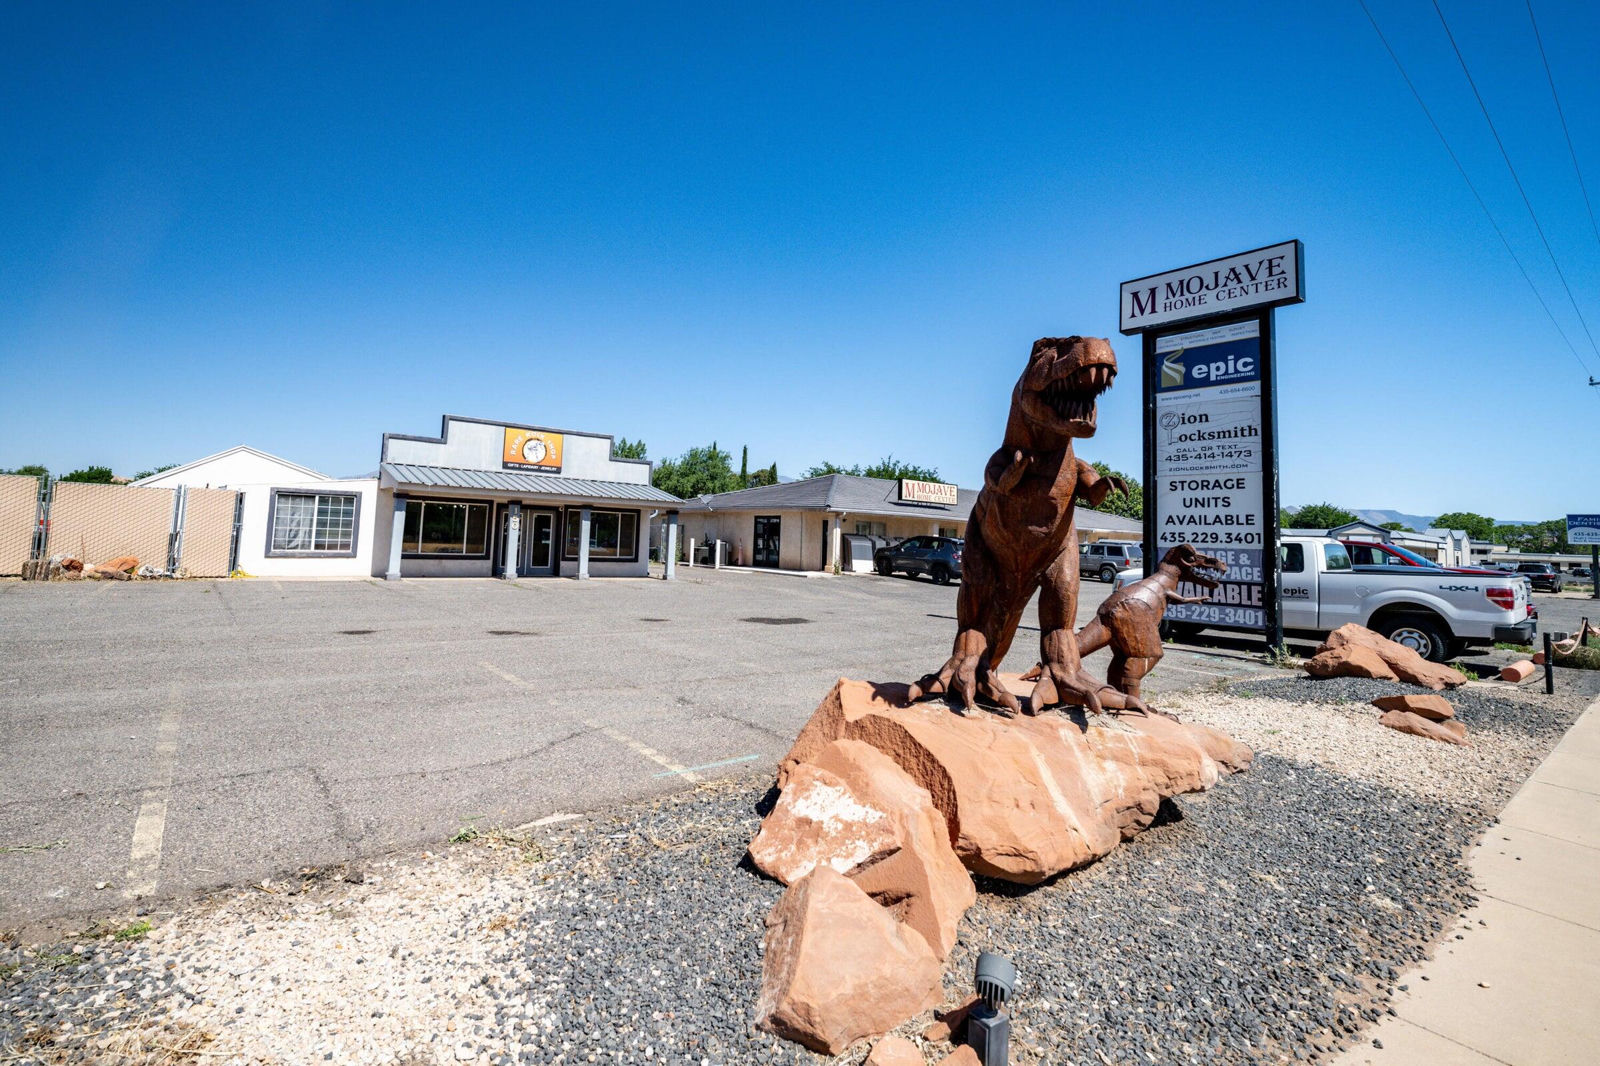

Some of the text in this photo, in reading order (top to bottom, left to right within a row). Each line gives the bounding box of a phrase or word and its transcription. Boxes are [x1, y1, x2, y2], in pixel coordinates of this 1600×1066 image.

[1129, 255, 1287, 319] M MOJAVE
[1163, 277, 1288, 312] HOME CENTER
[1191, 355, 1255, 381] epic
[1217, 371, 1255, 380] ENGINEERING
[1160, 412, 1209, 430] Zion
[1168, 425, 1259, 446] Locksmith
[1165, 450, 1253, 462] 435-414-1473
[1168, 463, 1249, 472] ZIONLOCKSMITH.COM
[905, 482, 955, 499] M MOJAVE
[1169, 478, 1245, 491] STORAGE
[1182, 496, 1231, 508] UNITS
[1165, 514, 1256, 526] AVAILABLE
[1160, 532, 1262, 544] 435.229.3401
[1239, 553, 1251, 565] &
[1283, 587, 1309, 596] epic
[1163, 604, 1263, 626] 35-229-3401
